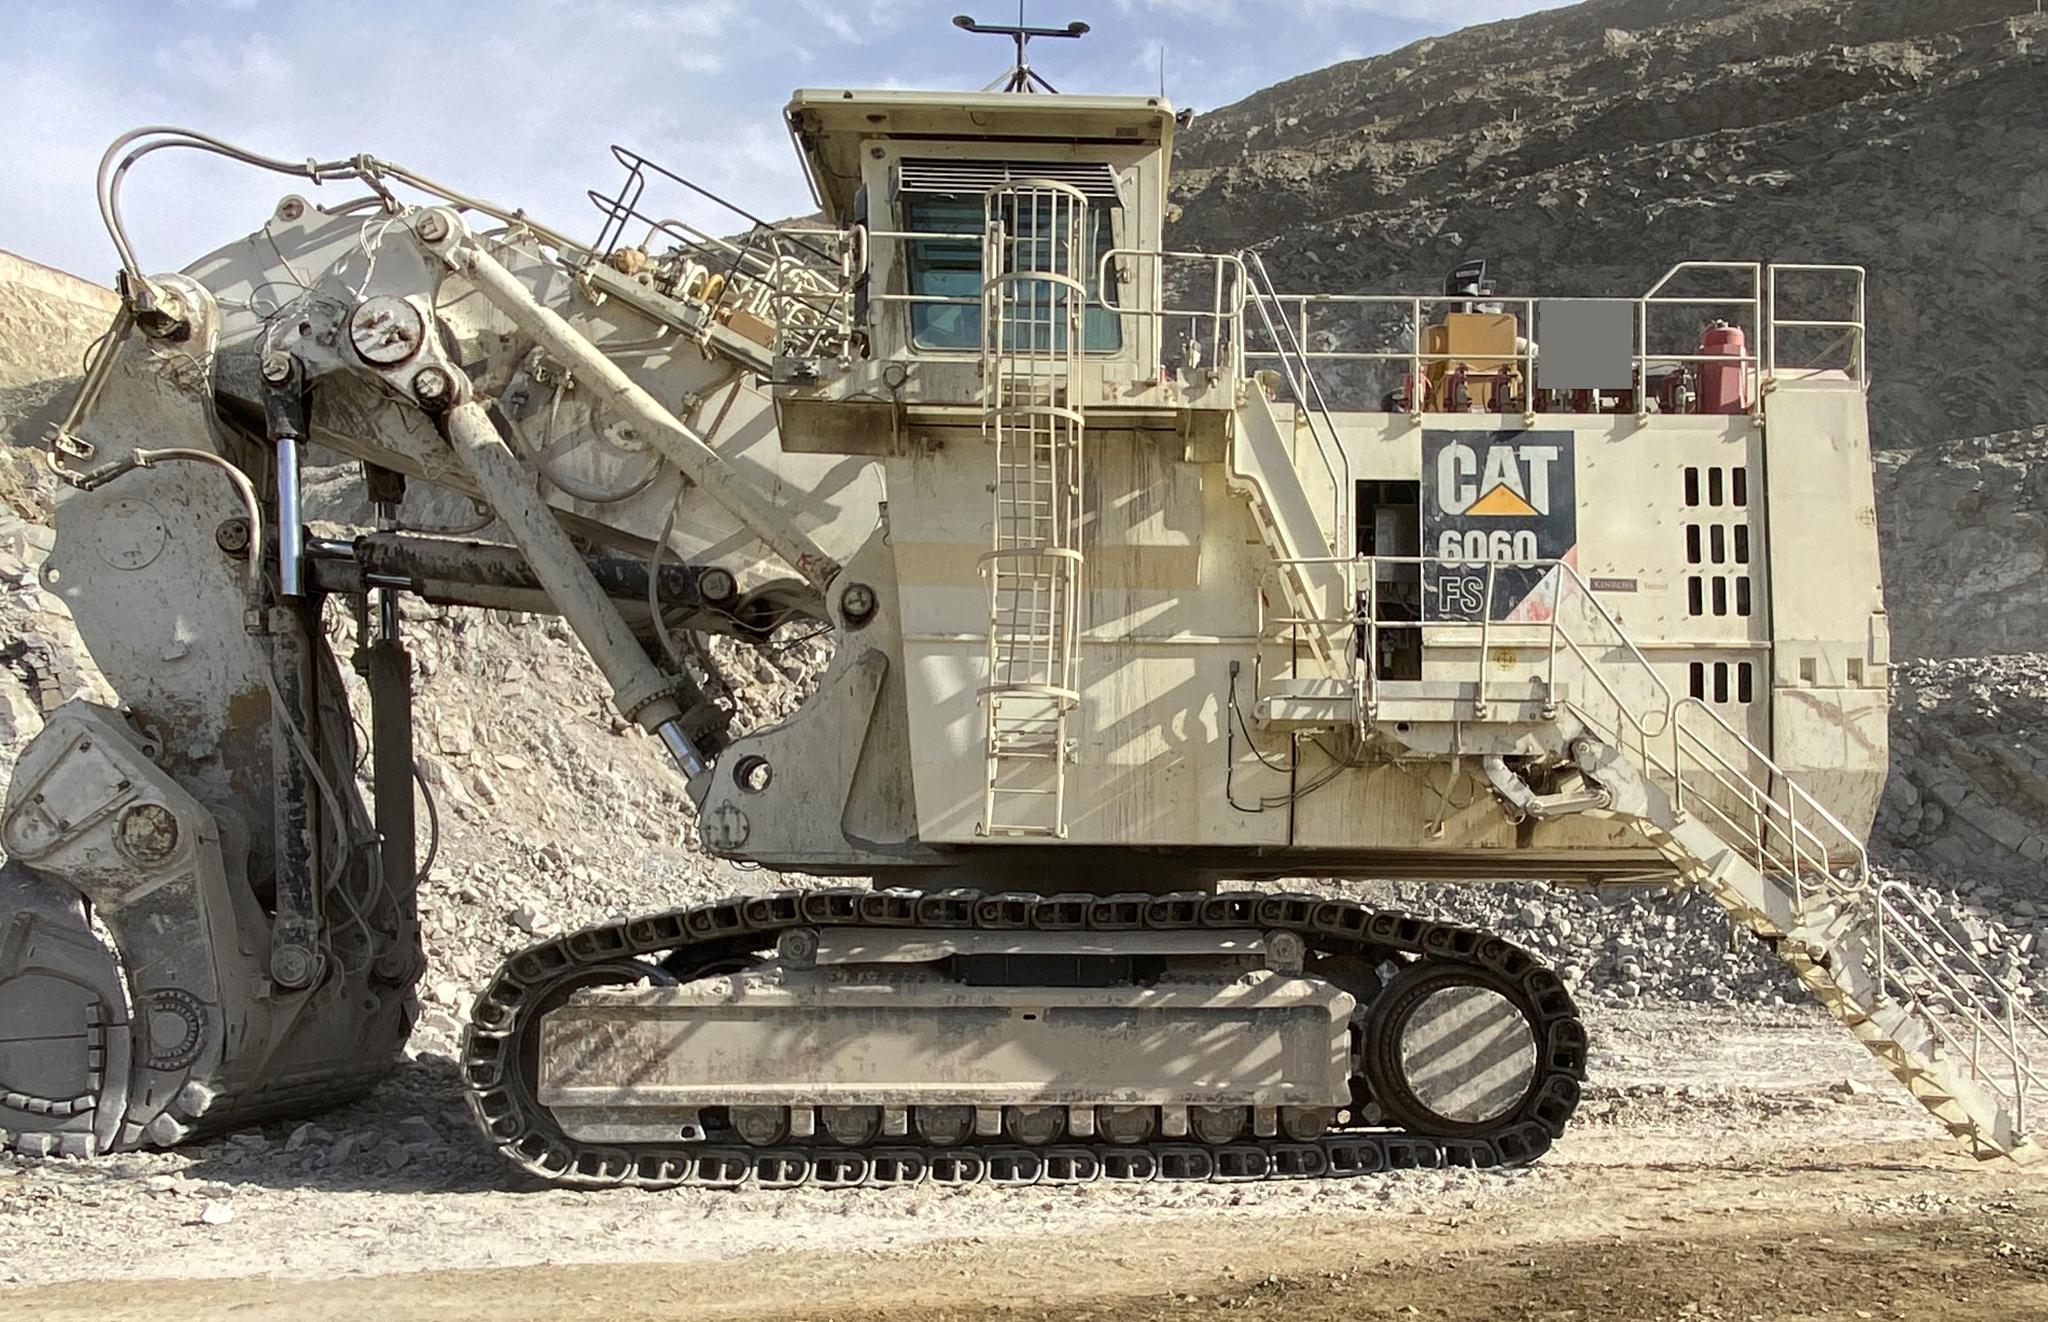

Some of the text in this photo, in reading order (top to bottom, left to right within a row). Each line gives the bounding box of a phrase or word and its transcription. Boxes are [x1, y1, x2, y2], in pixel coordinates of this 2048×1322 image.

[1437, 443, 1558, 516] CAT
[1439, 529, 1538, 569] 6060
[1439, 576, 1484, 614] FS
